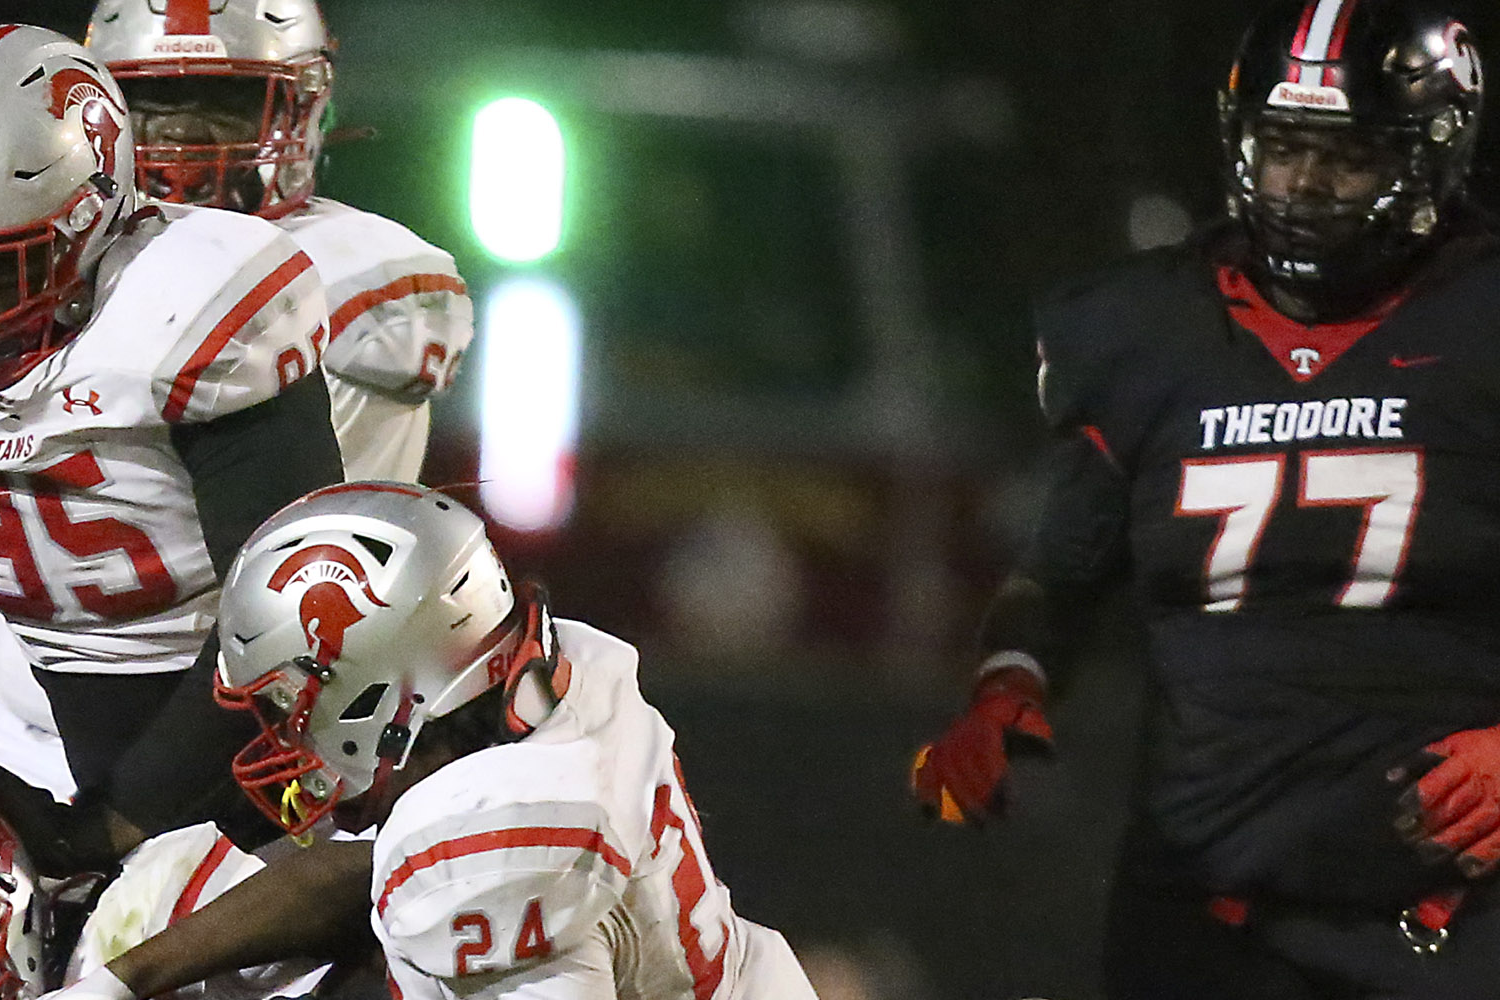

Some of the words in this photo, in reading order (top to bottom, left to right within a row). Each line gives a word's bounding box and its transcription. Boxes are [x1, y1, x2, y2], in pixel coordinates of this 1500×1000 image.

[1290, 347, 1320, 375] T
[1200, 397, 1408, 450] THEODORE
[1173, 446, 1425, 613] 77
[449, 896, 558, 980] 24
